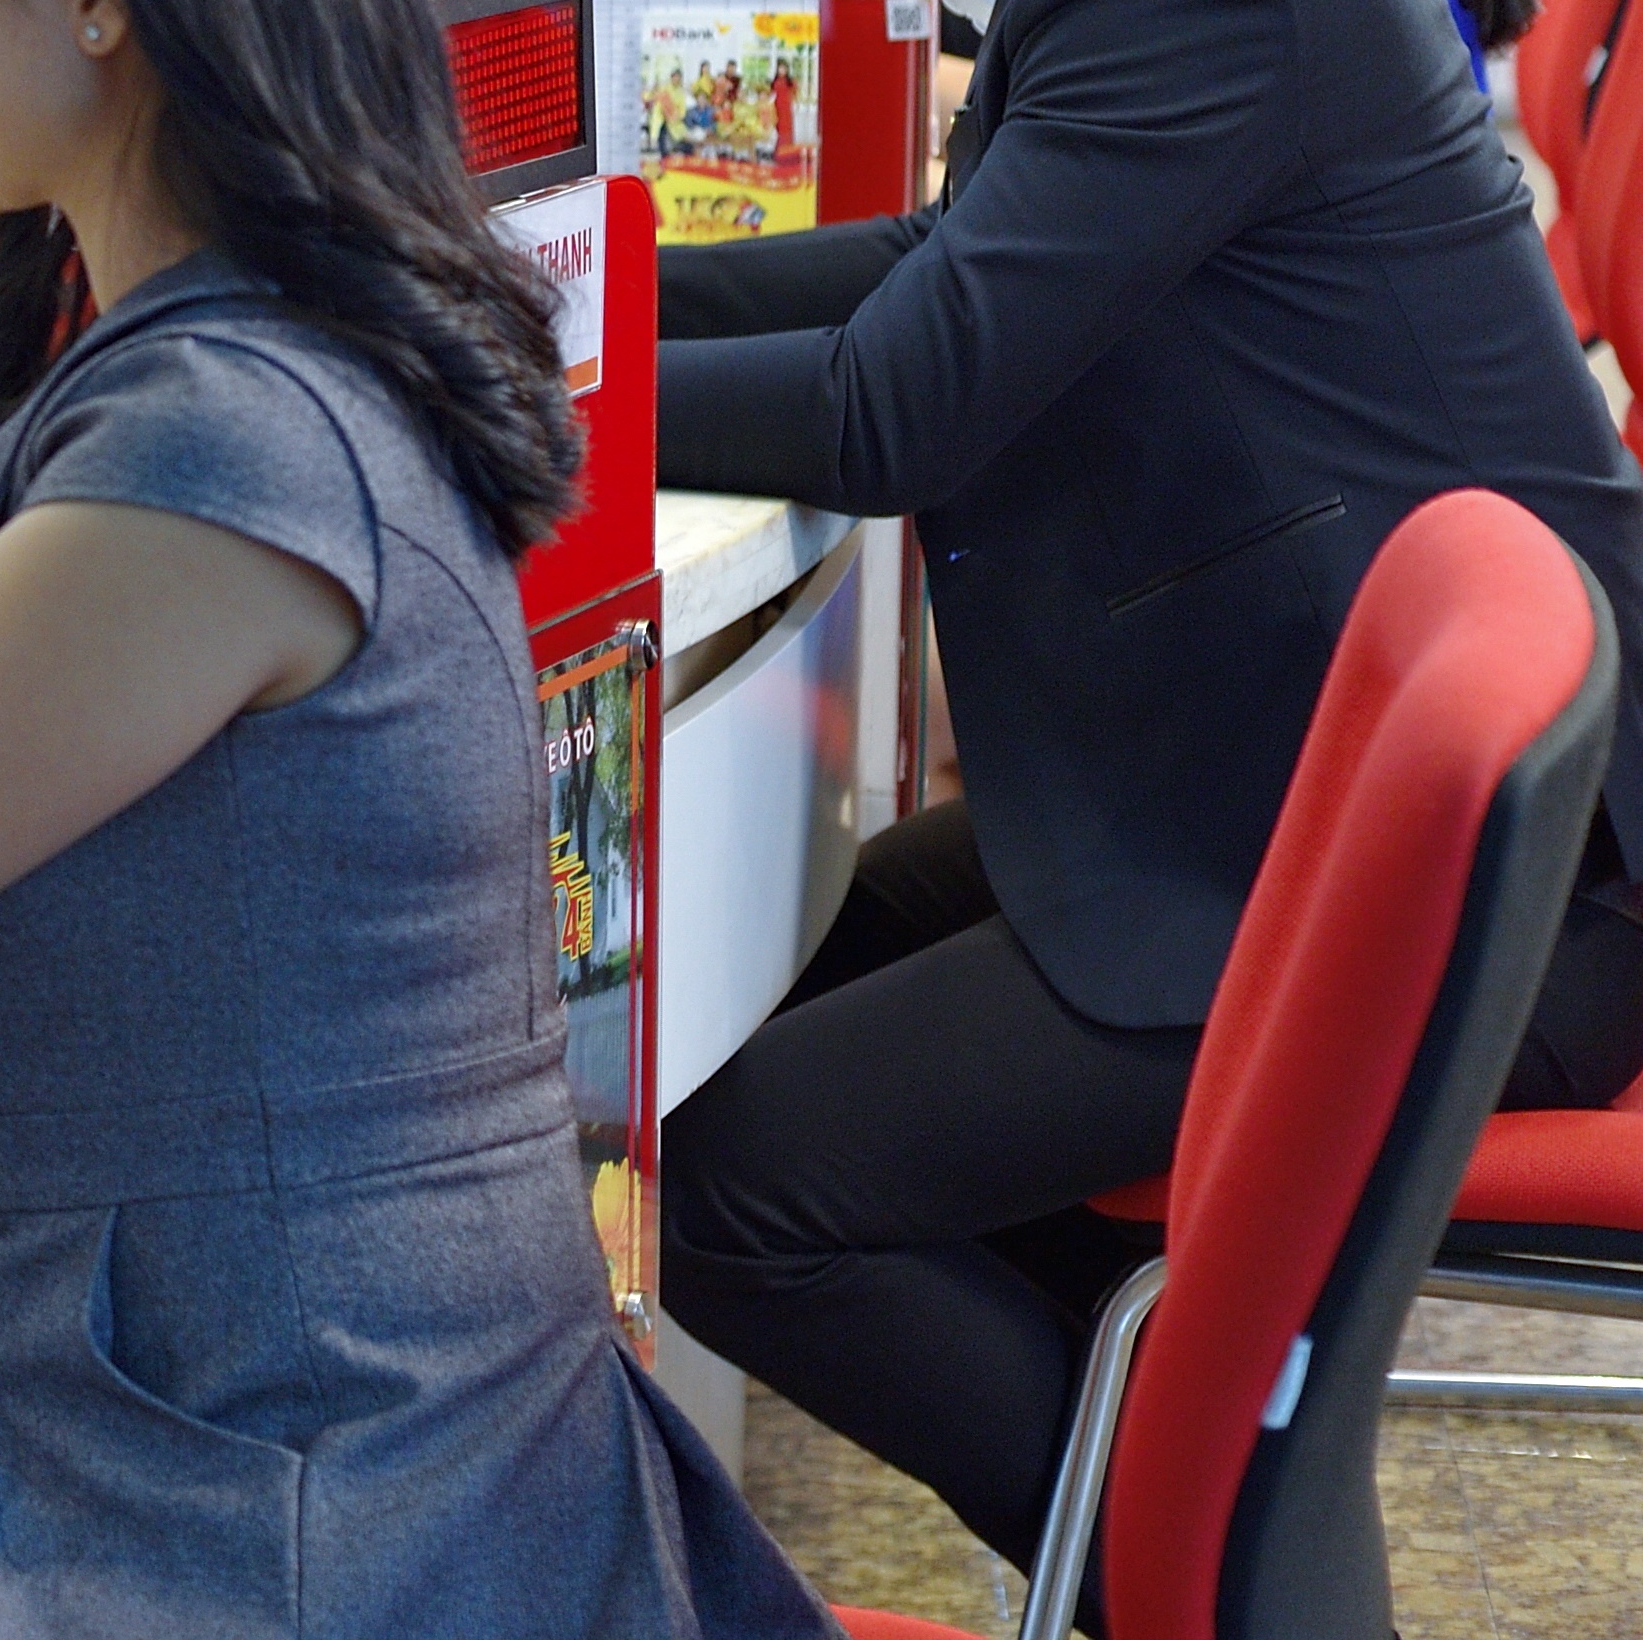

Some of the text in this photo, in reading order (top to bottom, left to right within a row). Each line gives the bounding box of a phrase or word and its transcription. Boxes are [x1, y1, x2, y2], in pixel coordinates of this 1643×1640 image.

[537, 227, 592, 284] THANH
[544, 716, 594, 773] E Ô TÔ
